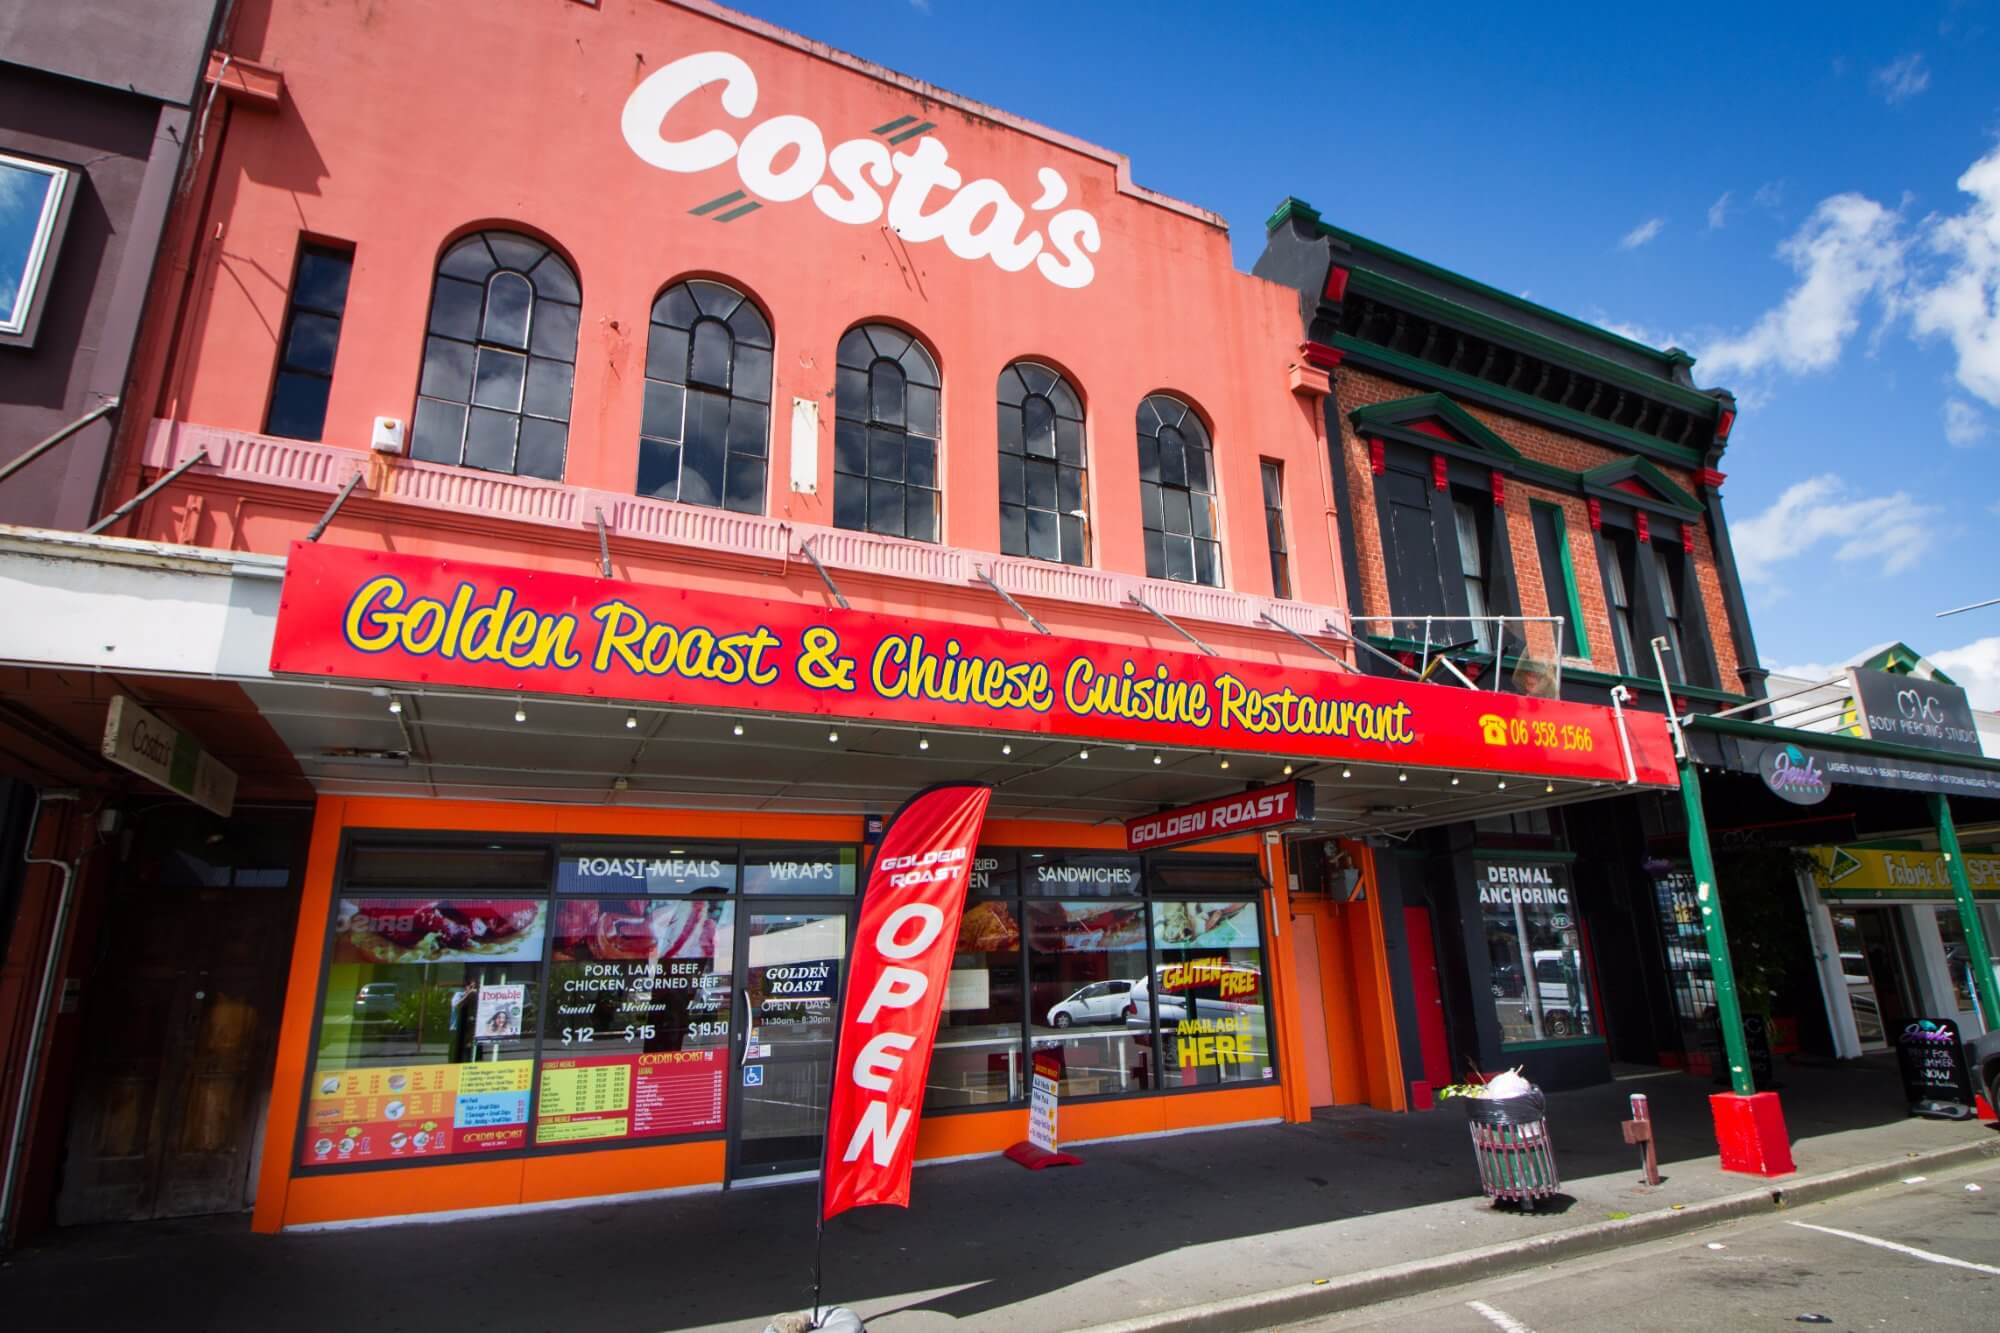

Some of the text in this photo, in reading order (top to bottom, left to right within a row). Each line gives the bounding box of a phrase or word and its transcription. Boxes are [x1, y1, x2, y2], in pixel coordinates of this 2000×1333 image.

[621, 51, 1100, 288] Costa's
[345, 574, 1416, 745] Golden Roast & Chinese Cuisine Restaurant
[1510, 719, 1593, 752] 06 358 1566
[1868, 714, 1976, 744] BODY PIERCING STUDIO
[1132, 792, 1289, 844] GOLDEN ROAST
[577, 857, 721, 878] ROAST MEALS
[881, 847, 967, 871] GOLDEN
[973, 857, 998, 871] RIED
[769, 861, 834, 881] WRAPS
[890, 865, 962, 887] ROAST
[1037, 865, 1132, 884] SANDWICHES
[1487, 866, 1553, 884] DERMAL
[1883, 855, 1936, 885] Fabric
[1479, 887, 1568, 904] ANCHORING
[584, 963, 702, 977] PORK, LAMB, BEEF,
[766, 966, 830, 979] GOLDEN
[1162, 957, 1223, 990] GLUTEN
[563, 976, 719, 992] CHICKEN, CORNED BEEF
[771, 980, 823, 993] ROAST
[1220, 972, 1256, 997] FREE
[557, 1000, 721, 1015] Small Medium Large
[761, 999, 831, 1012] OPEN 7 DAYS
[687, 1021, 729, 1041] $19.50
[842, 902, 944, 1168] OPEN
[1176, 1015, 1250, 1035] AVAILABLE
[1177, 1034, 1254, 1068] HERE
